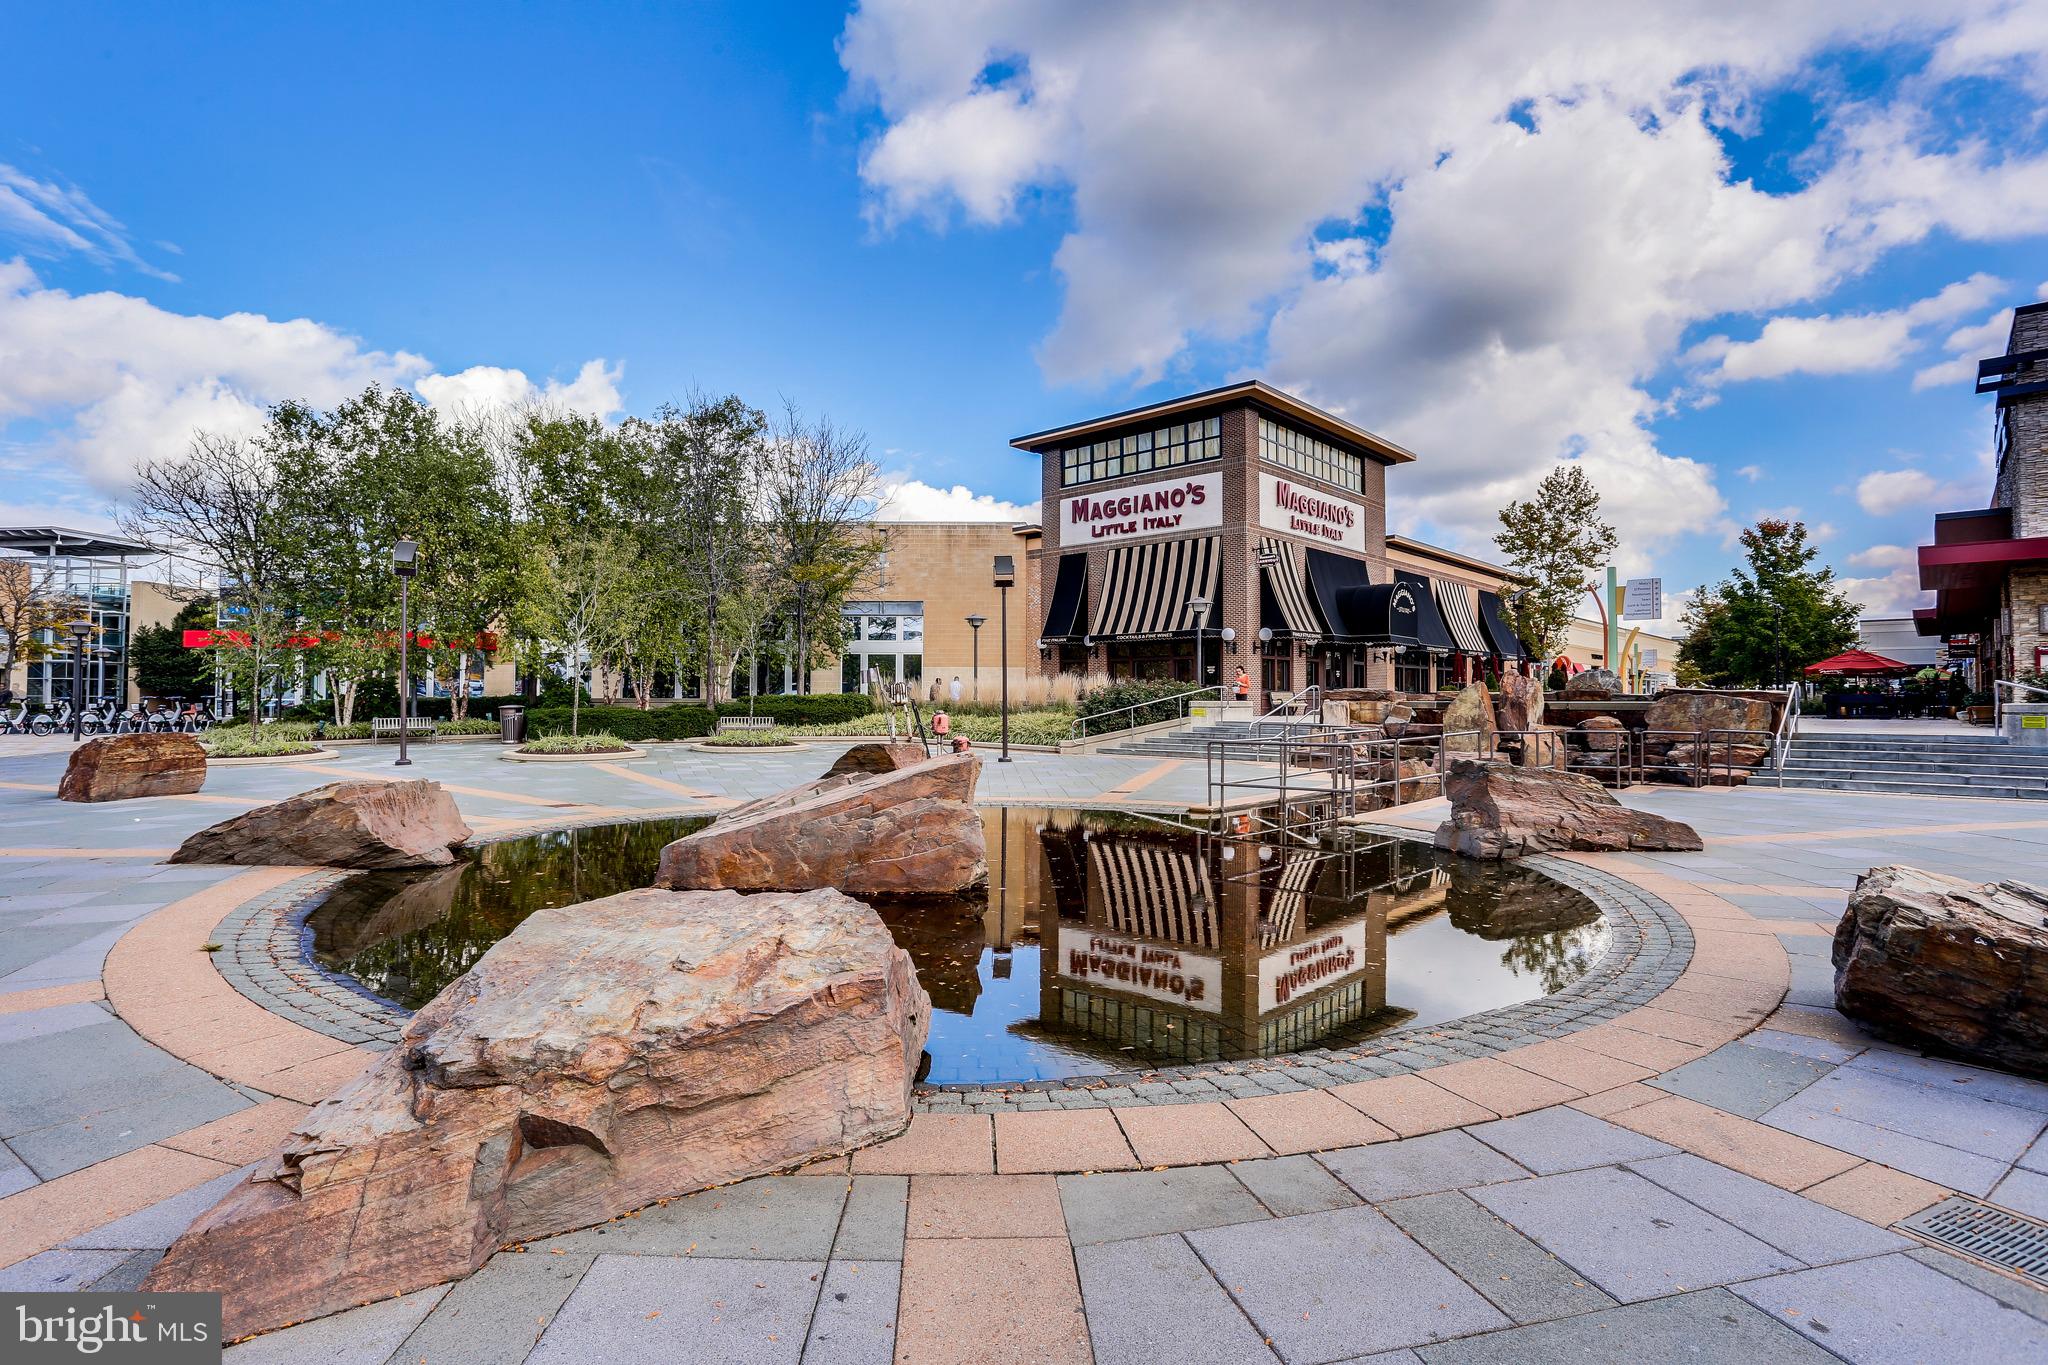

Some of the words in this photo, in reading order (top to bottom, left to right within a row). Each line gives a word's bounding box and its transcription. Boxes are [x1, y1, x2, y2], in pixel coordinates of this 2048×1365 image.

[1071, 482, 1206, 524] MAGGIANO'S
[1276, 480, 1355, 528] MAGGIANO'S
[1091, 520, 1137, 538] LITTLE
[1143, 514, 1182, 530] ITALY
[1290, 515, 1320, 536] LITTLE
[1321, 524, 1344, 541] ITALY
